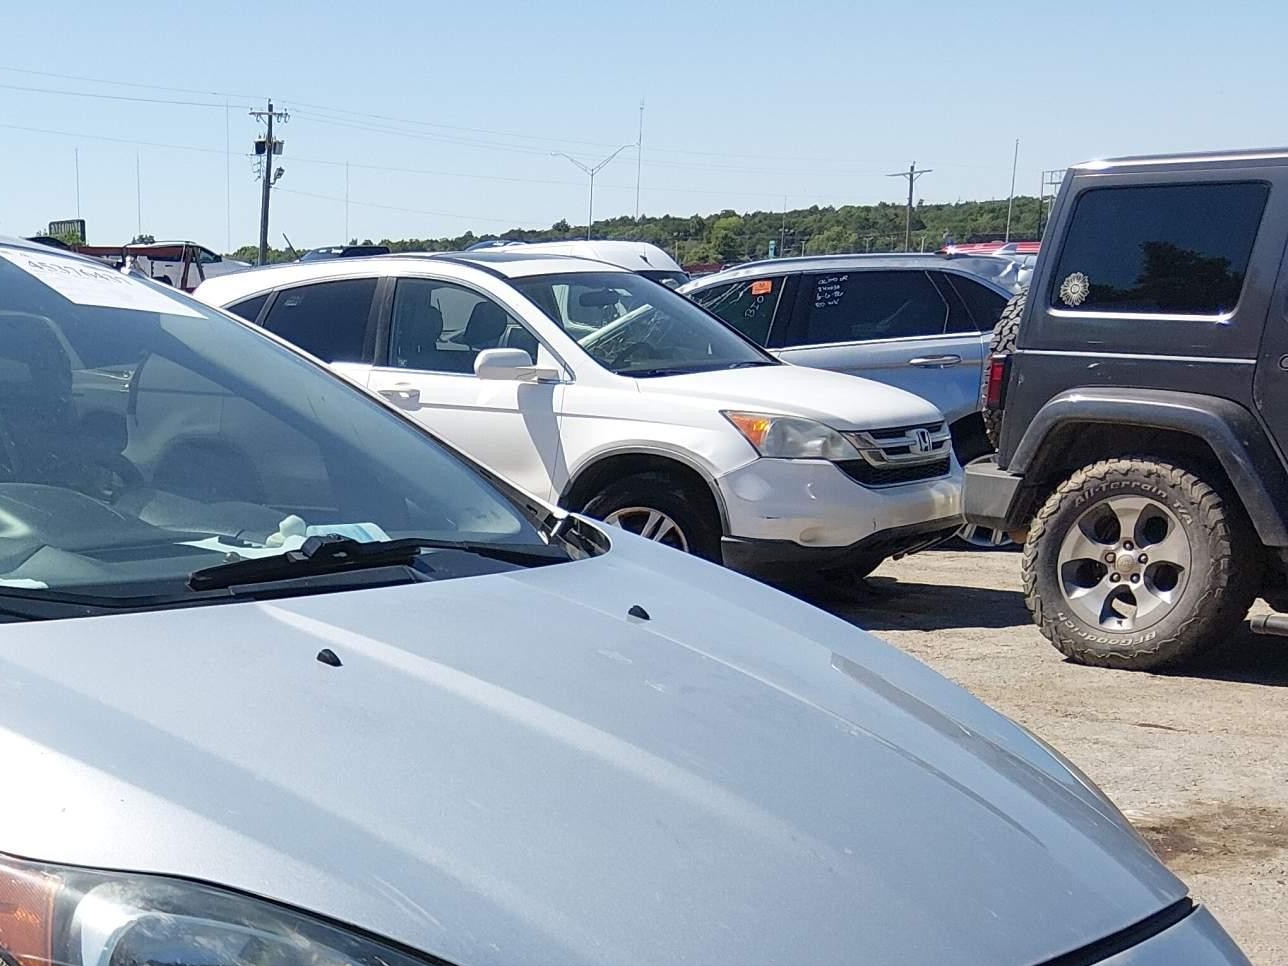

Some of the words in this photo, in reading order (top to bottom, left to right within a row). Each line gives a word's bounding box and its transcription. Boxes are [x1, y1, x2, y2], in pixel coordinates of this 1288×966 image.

[1074, 480, 1168, 507] All-Terrain
[1172, 498, 1194, 525] T/A
[1057, 611, 1157, 646] BFGoodrich
